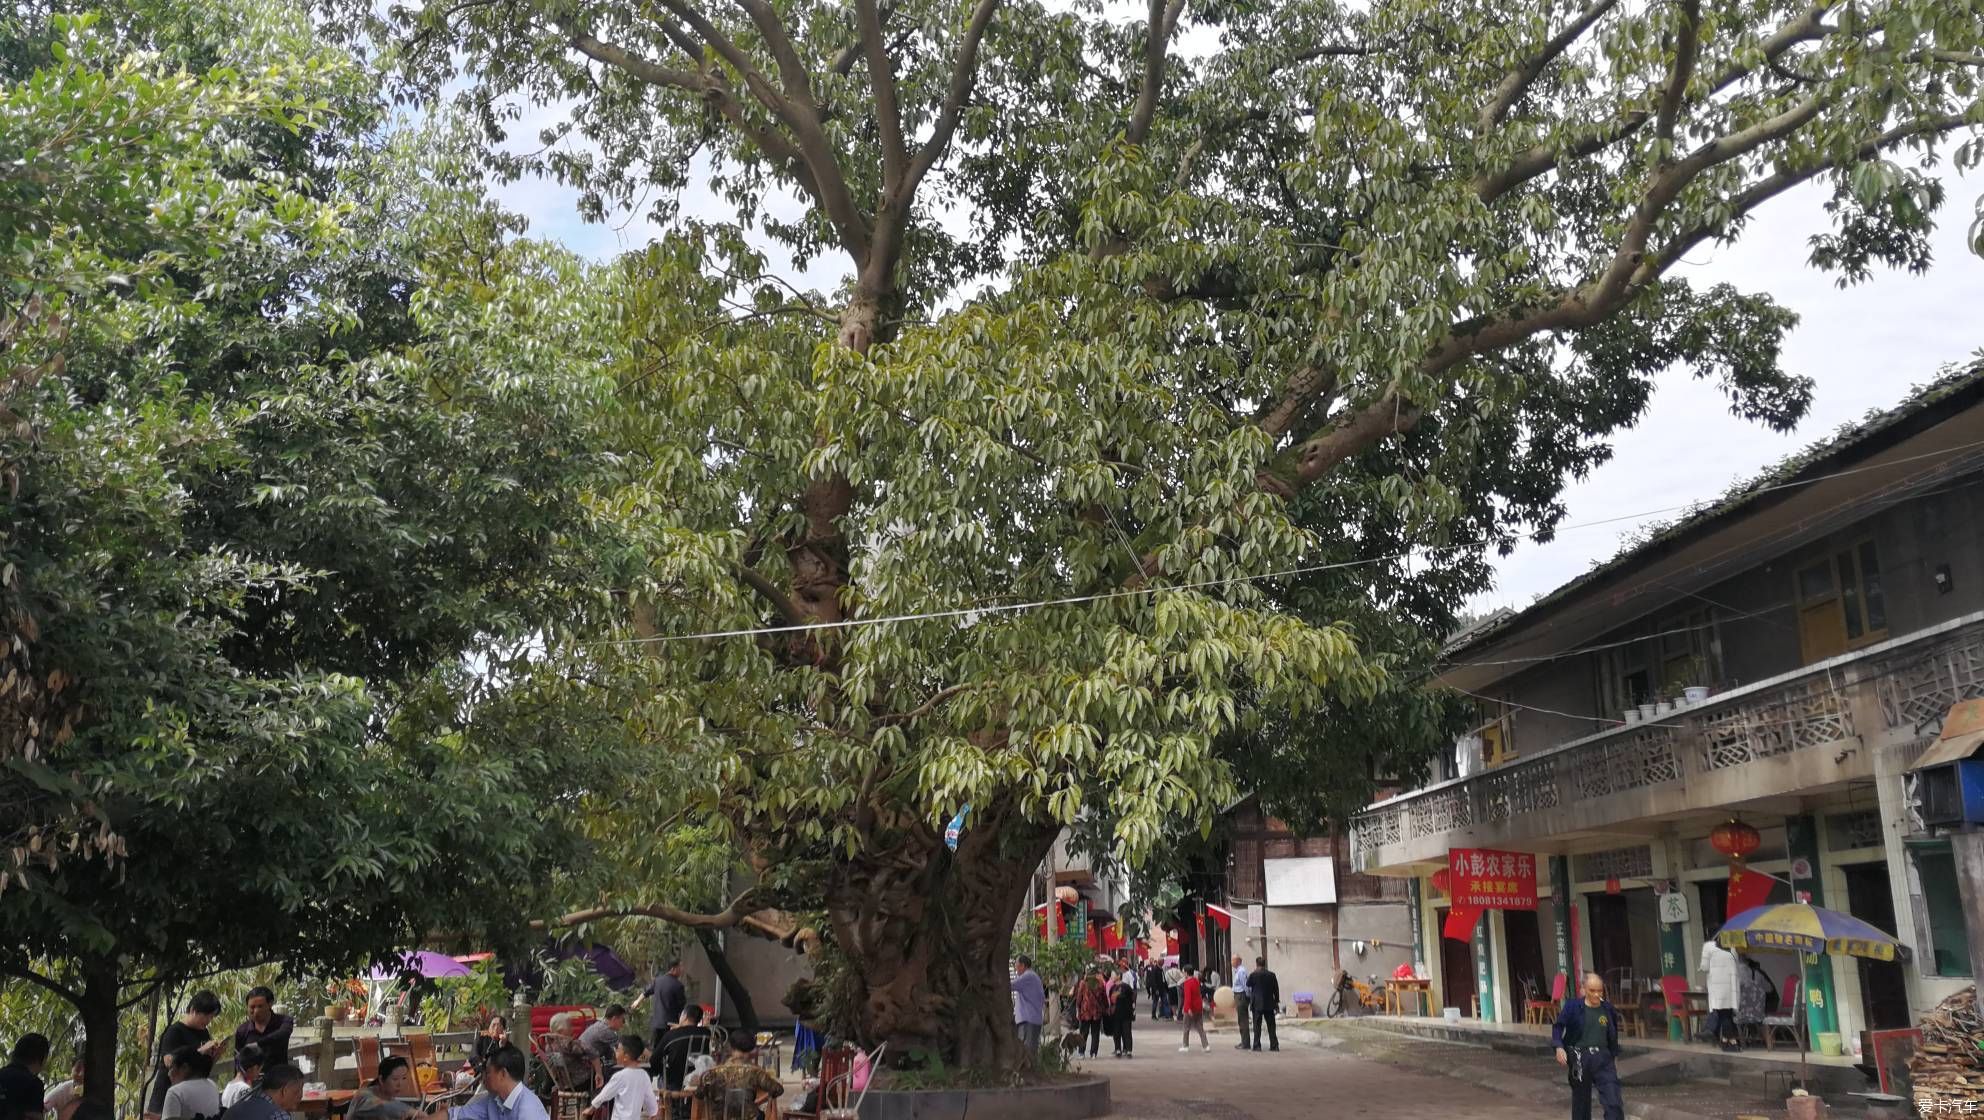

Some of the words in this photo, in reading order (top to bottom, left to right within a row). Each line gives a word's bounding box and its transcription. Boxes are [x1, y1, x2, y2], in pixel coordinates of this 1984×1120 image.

[1455, 853, 1531, 879] 小彭农家乐
[1667, 897, 1683, 919] 茶
